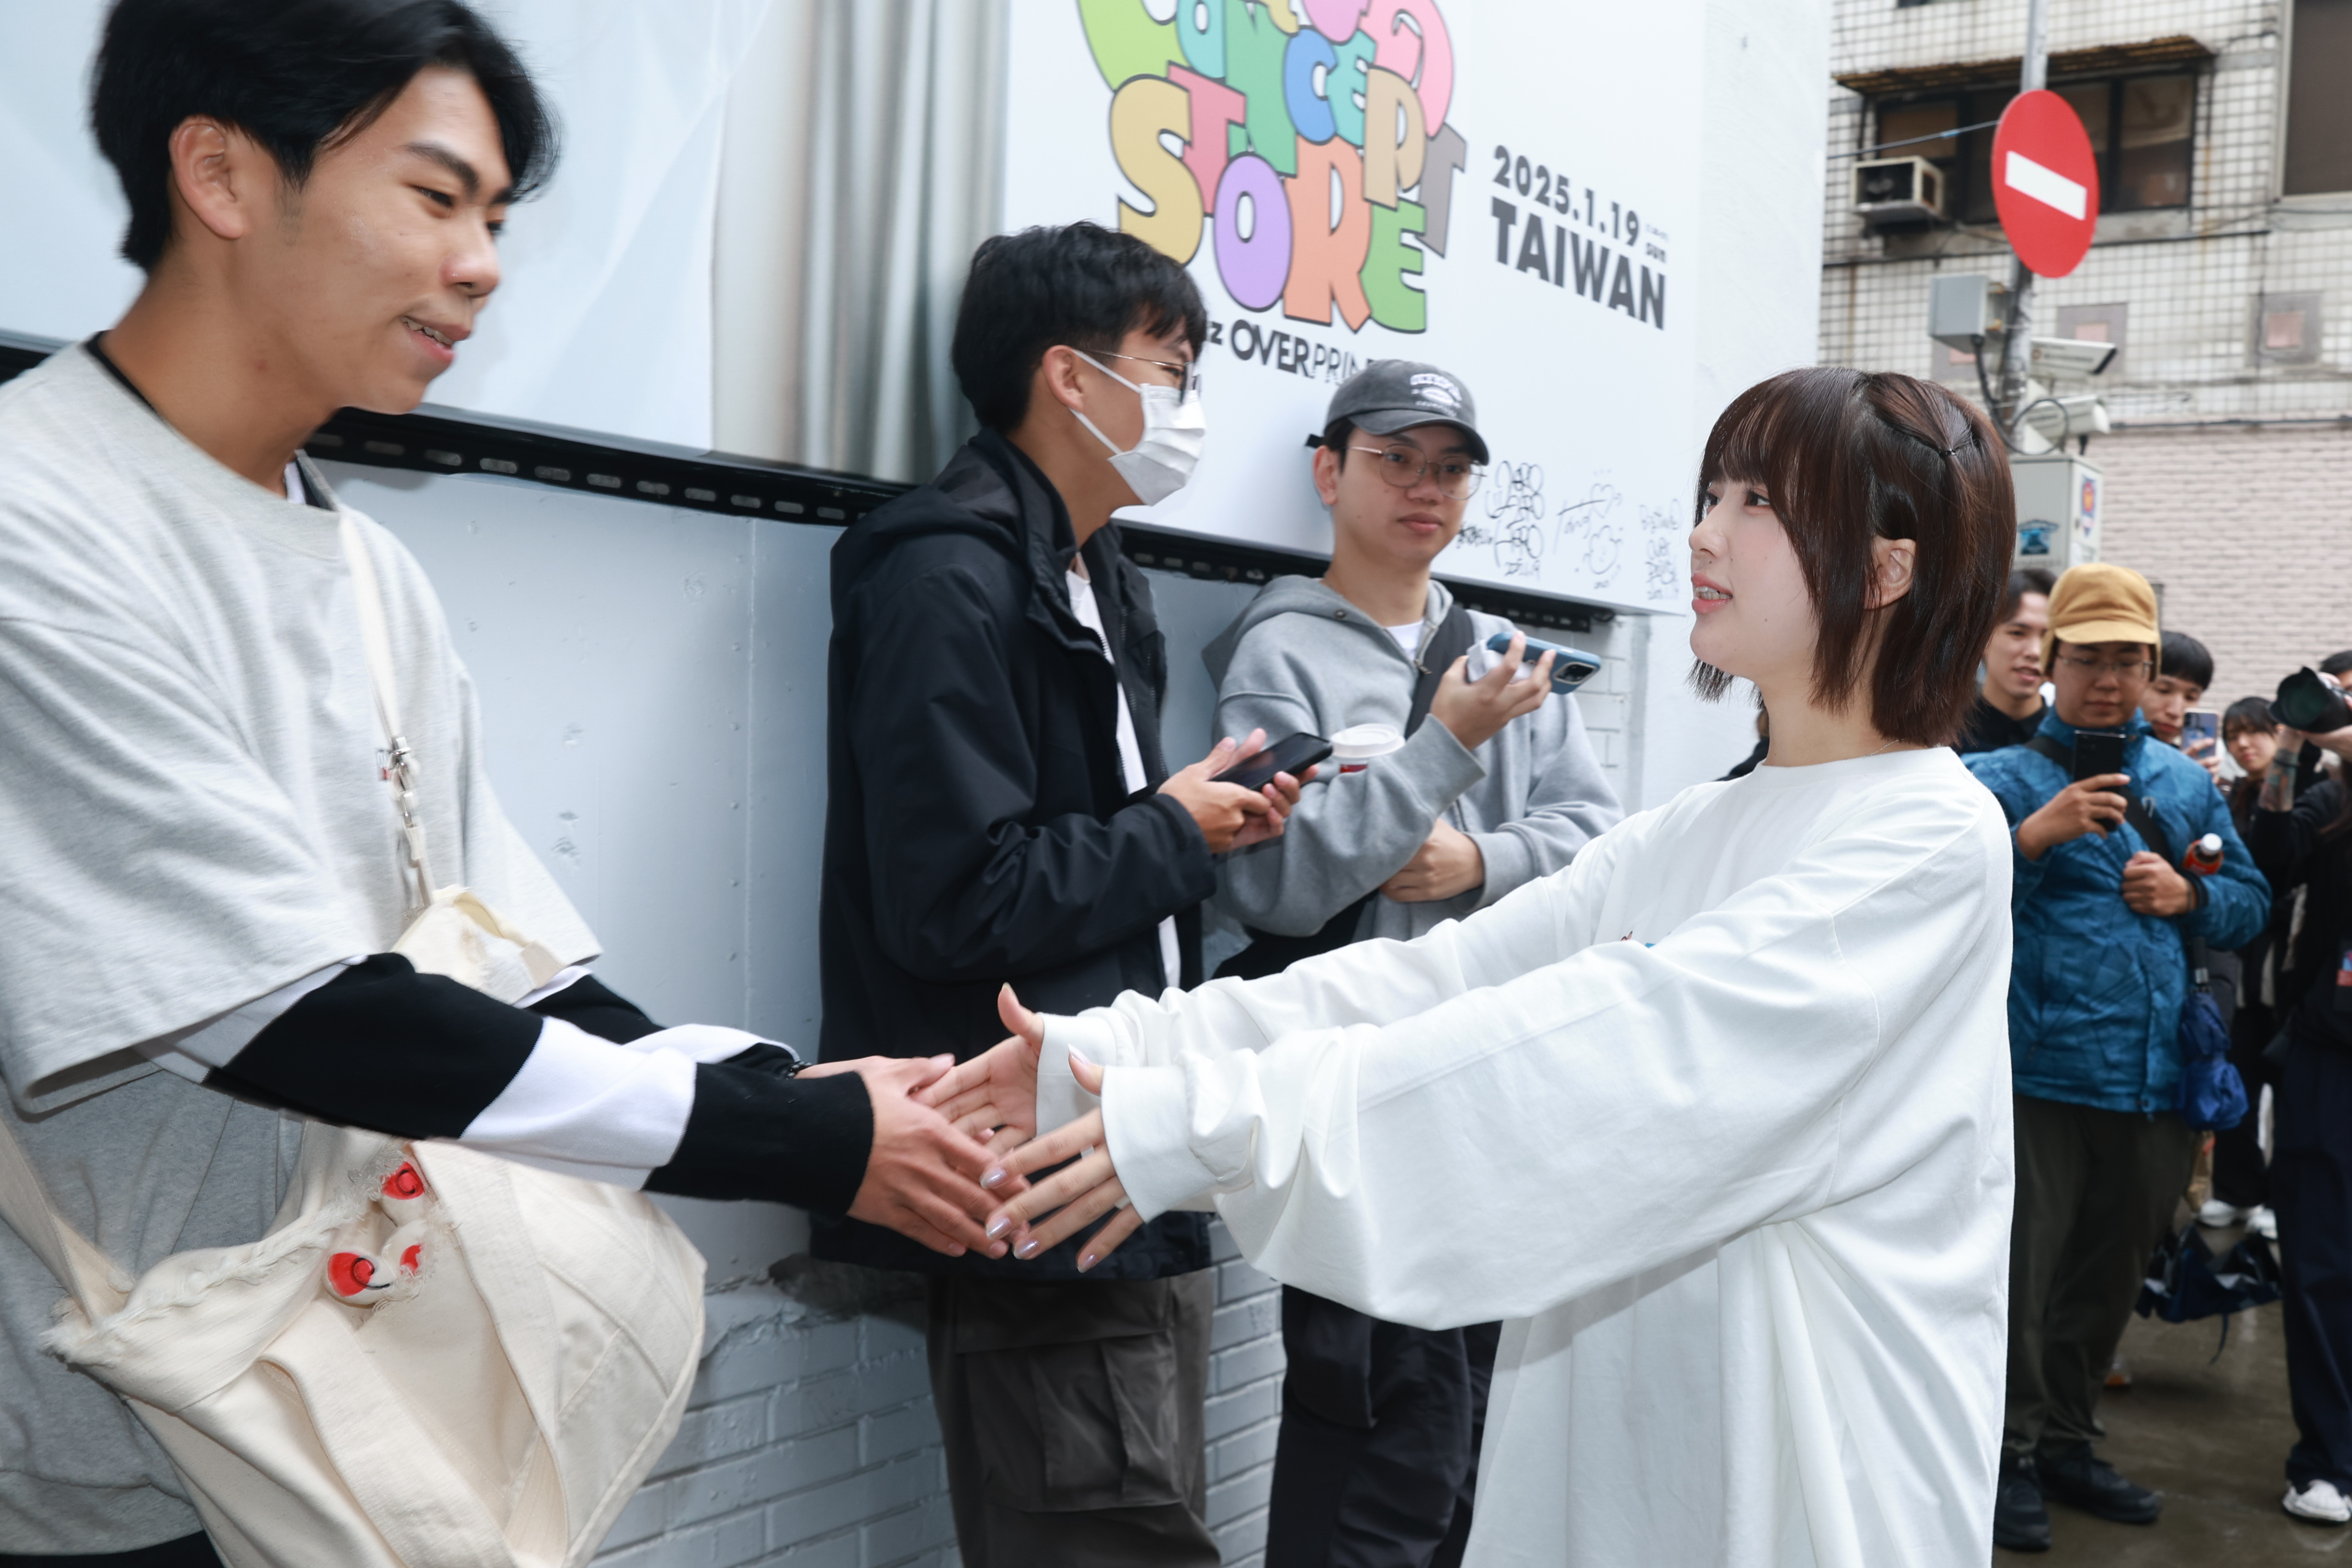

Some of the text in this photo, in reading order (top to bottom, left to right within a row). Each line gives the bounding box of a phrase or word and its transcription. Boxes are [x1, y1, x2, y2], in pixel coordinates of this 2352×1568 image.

[1108, 59, 1426, 335] STORE
[1491, 195, 1666, 331] TAIWAN
[1492, 144, 1639, 247] 2025.1.19
